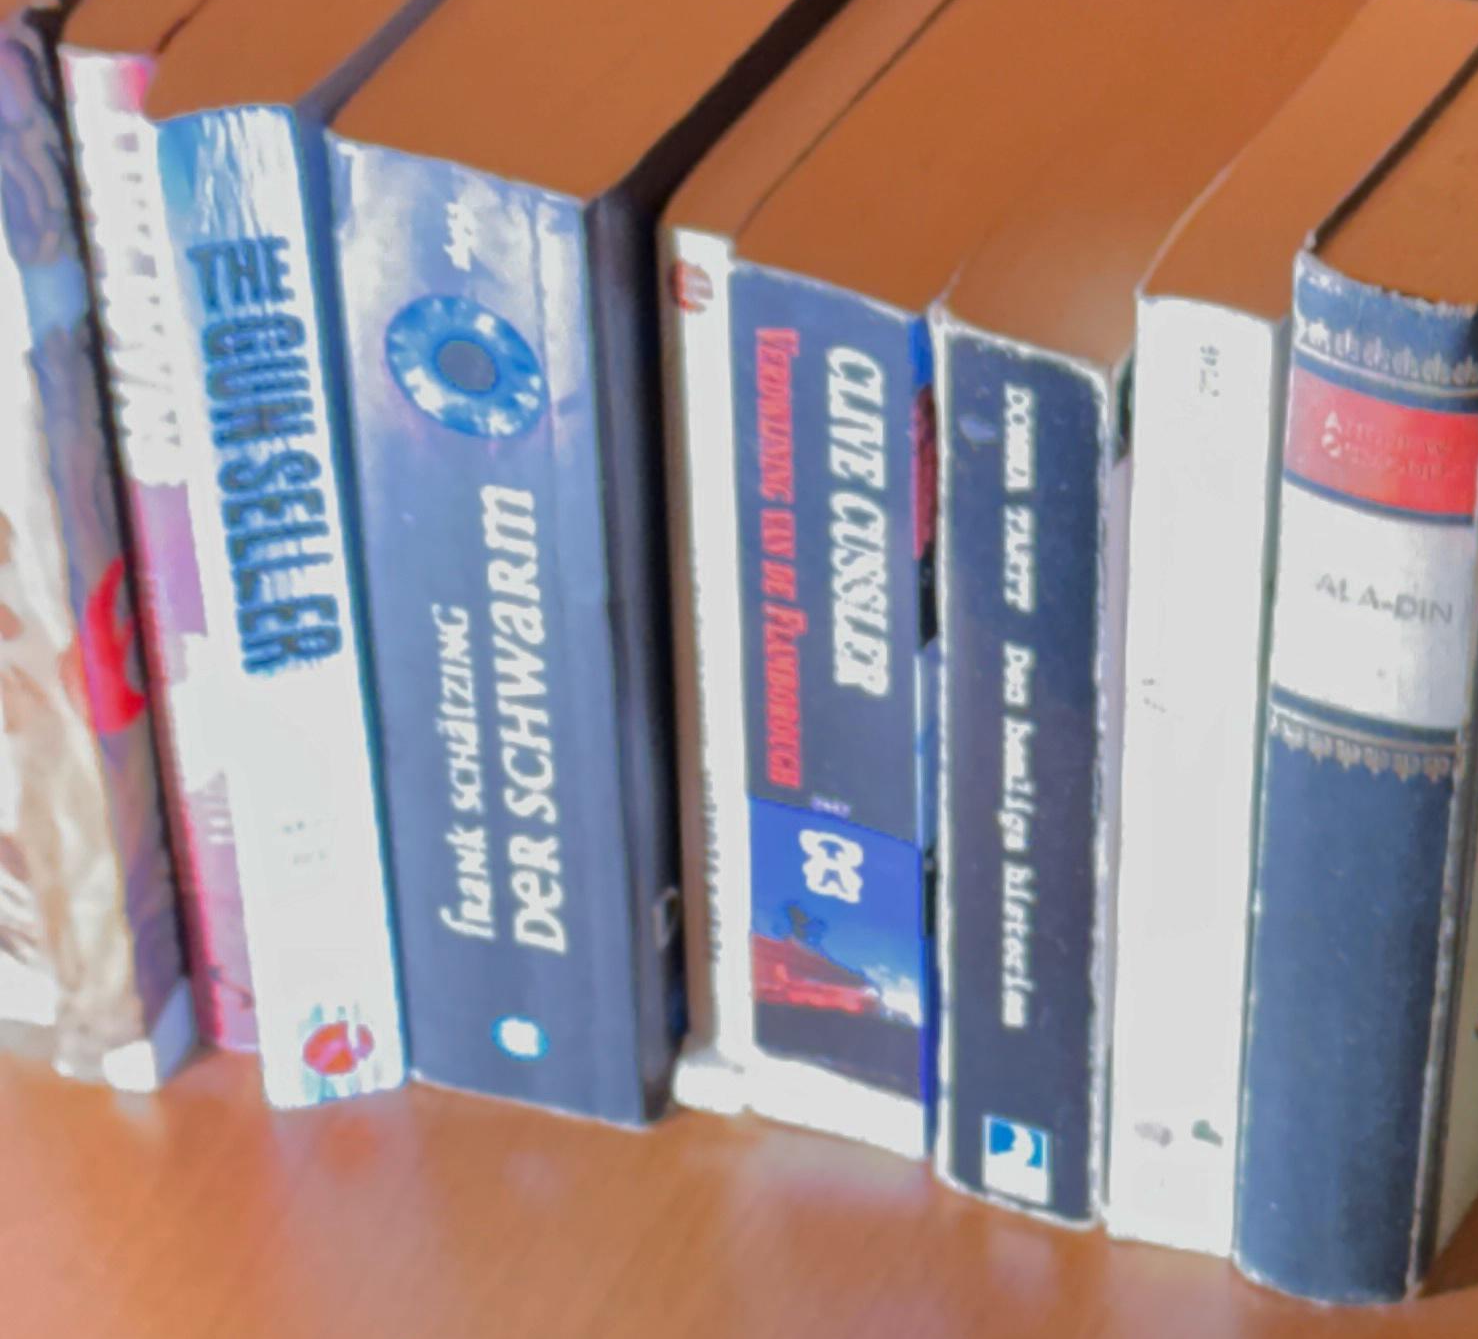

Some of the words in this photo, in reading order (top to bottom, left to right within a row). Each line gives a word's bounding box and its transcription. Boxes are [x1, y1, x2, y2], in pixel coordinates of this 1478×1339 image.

[188, 237, 296, 309] THE
[205, 313, 315, 449] GUN
[824, 346, 886, 490] CLIVE
[1004, 384, 1036, 491] DONNA
[217, 449, 342, 676] SELLER
[829, 492, 889, 697] CUSSLER
[1004, 505, 1036, 613] TARTT
